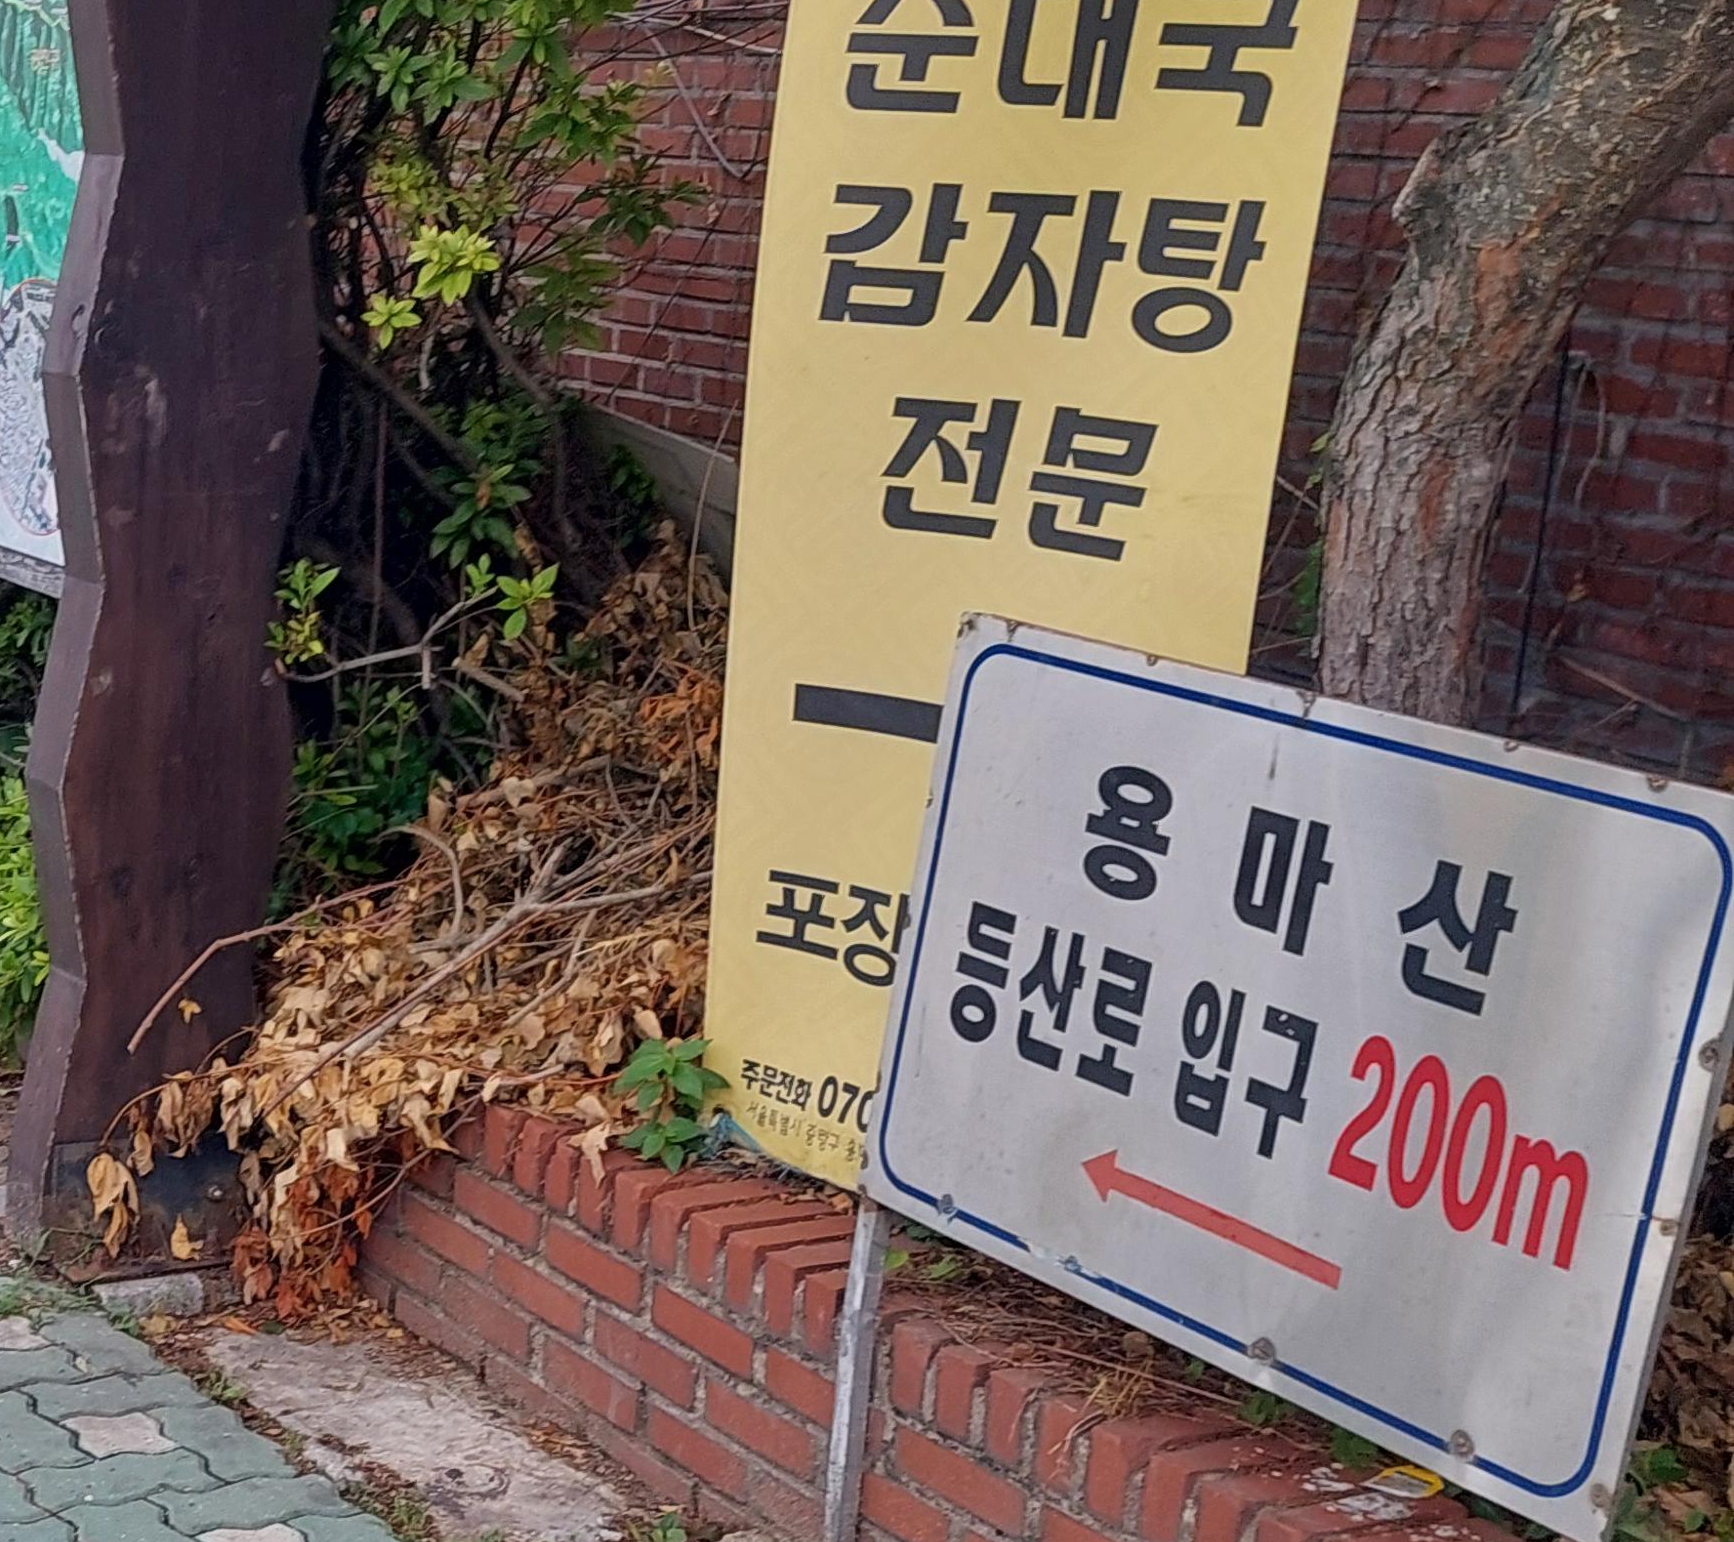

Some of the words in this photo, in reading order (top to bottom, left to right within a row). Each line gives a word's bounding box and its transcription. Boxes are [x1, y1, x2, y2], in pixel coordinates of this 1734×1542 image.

[818, 182, 1268, 354] 감자탕
[879, 396, 1159, 562] 전문
[740, 1059, 813, 1112] 주문전화
[1326, 1033, 1591, 1273] 200m
